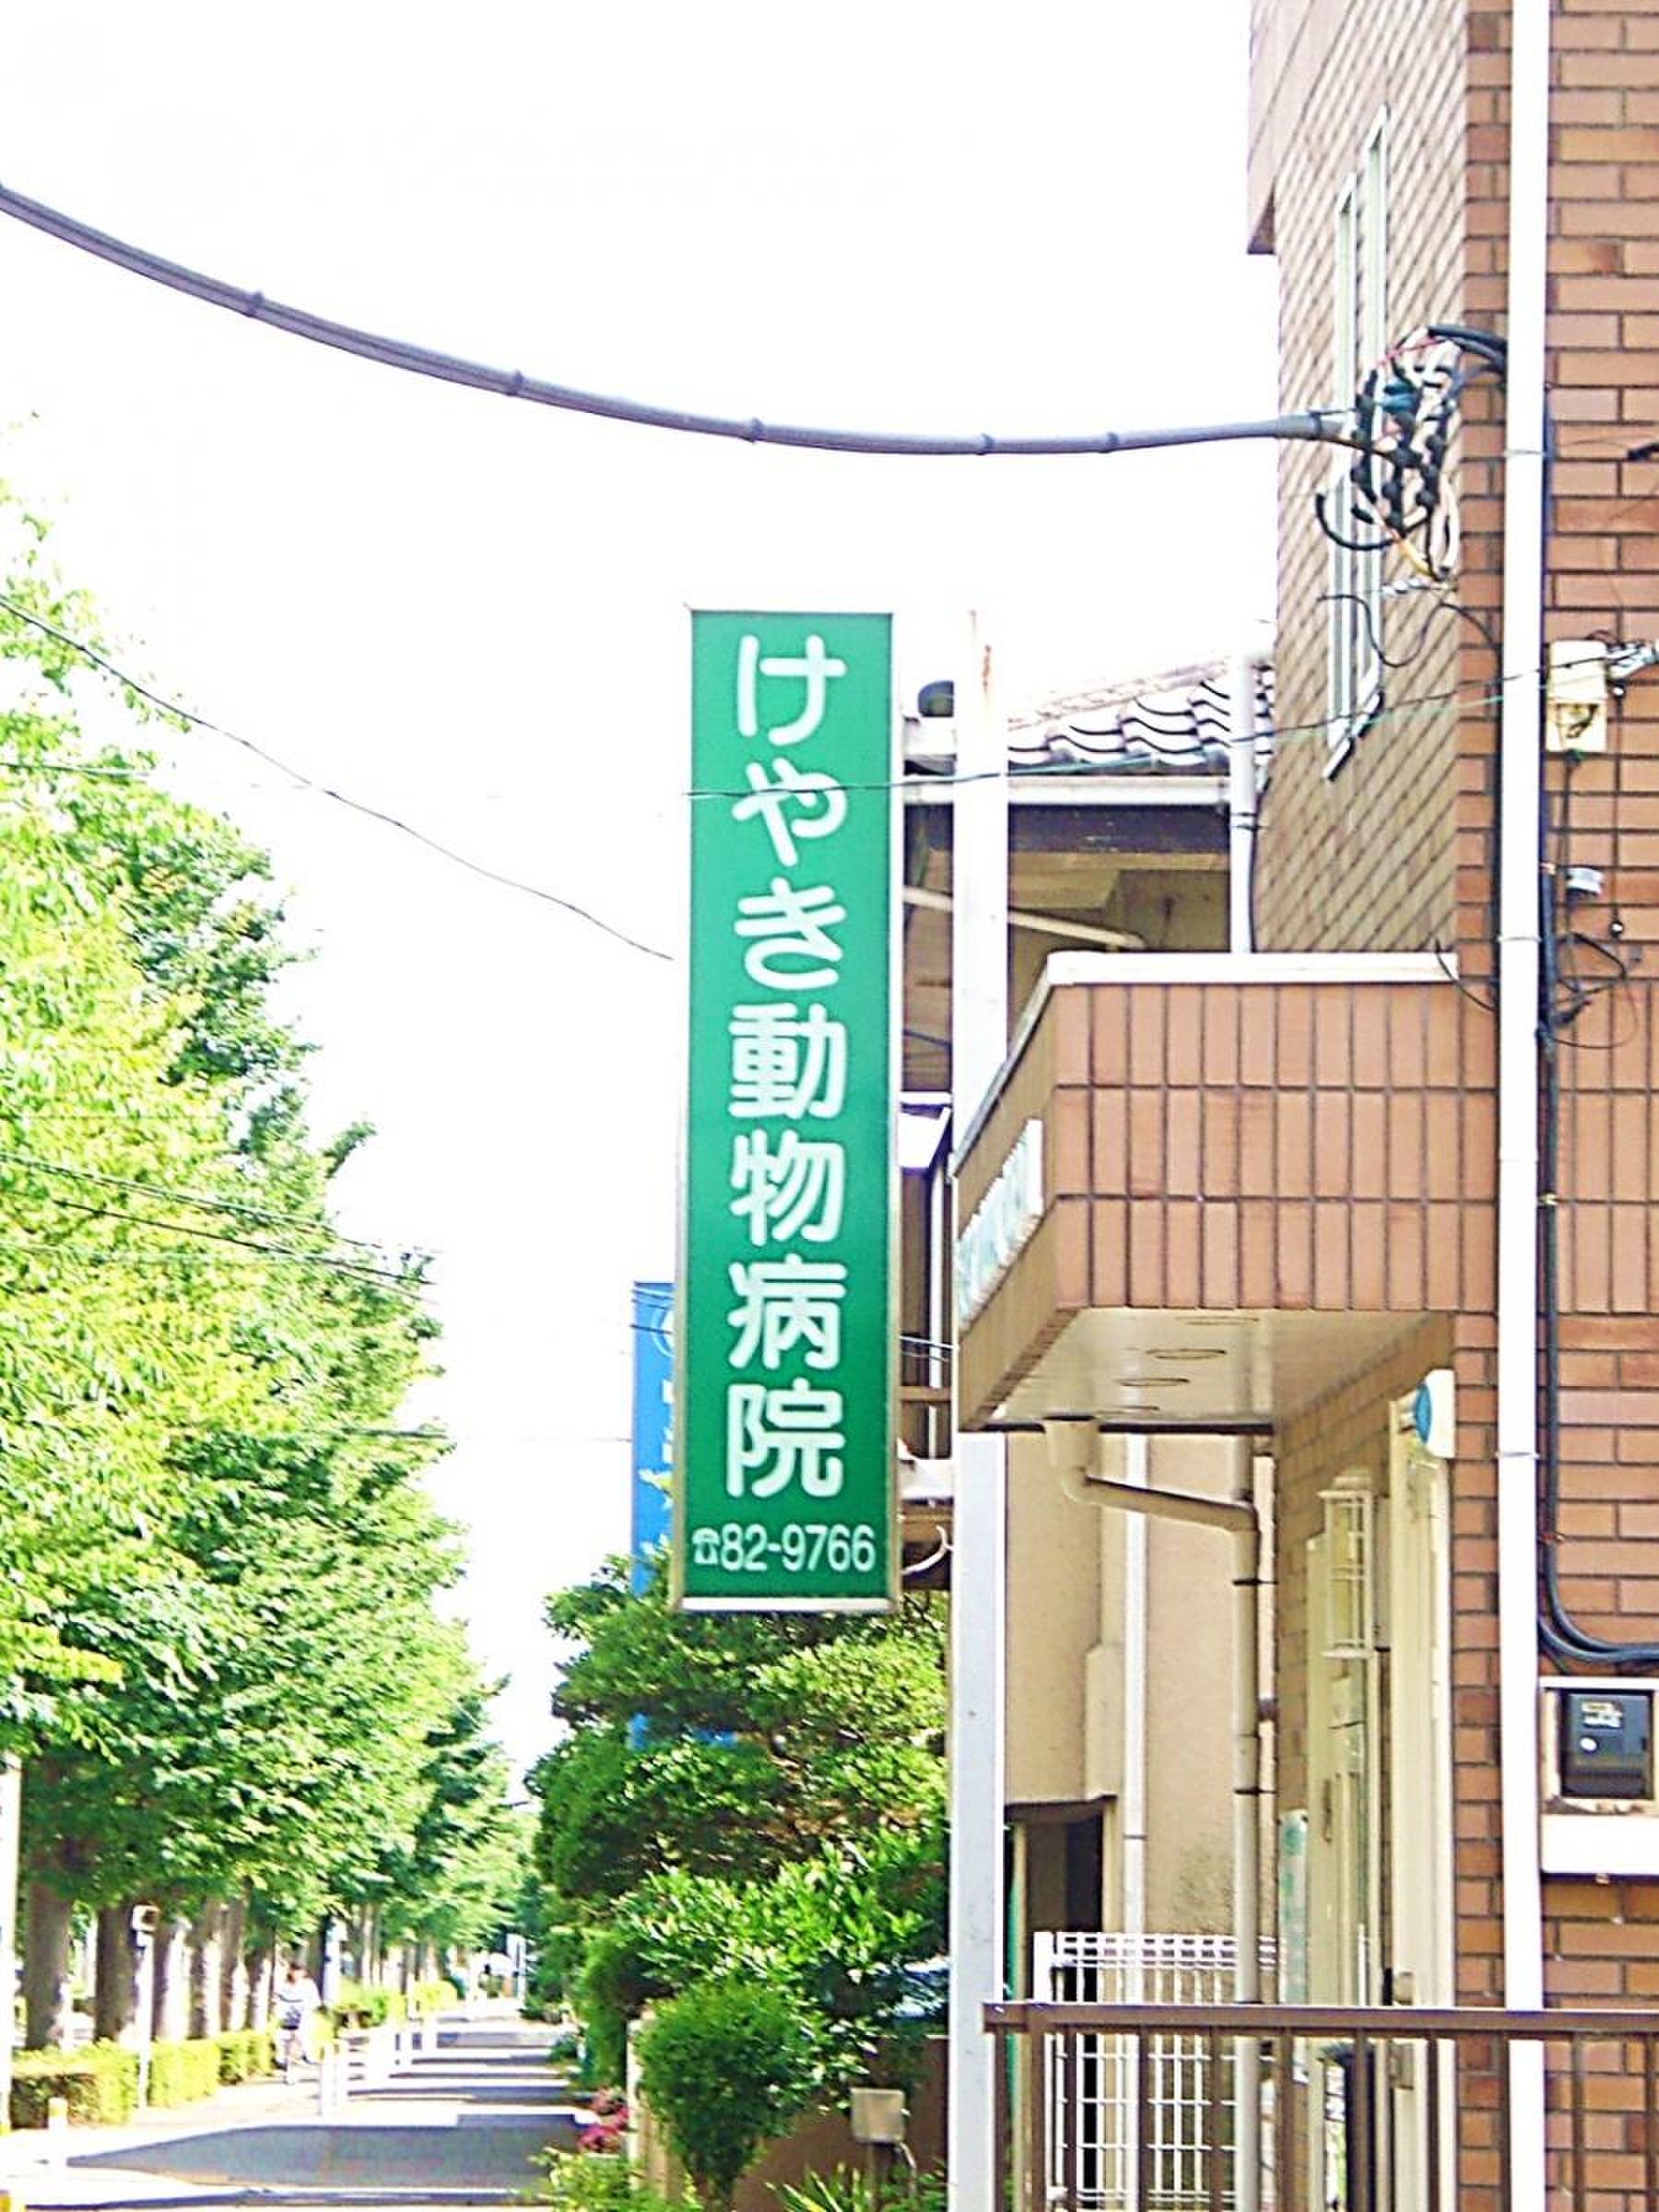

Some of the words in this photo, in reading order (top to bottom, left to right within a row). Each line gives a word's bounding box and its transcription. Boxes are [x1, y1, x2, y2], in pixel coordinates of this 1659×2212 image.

[727, 634, 847, 1498] けやき動物病院
[721, 1524, 876, 1571] 82-9766
